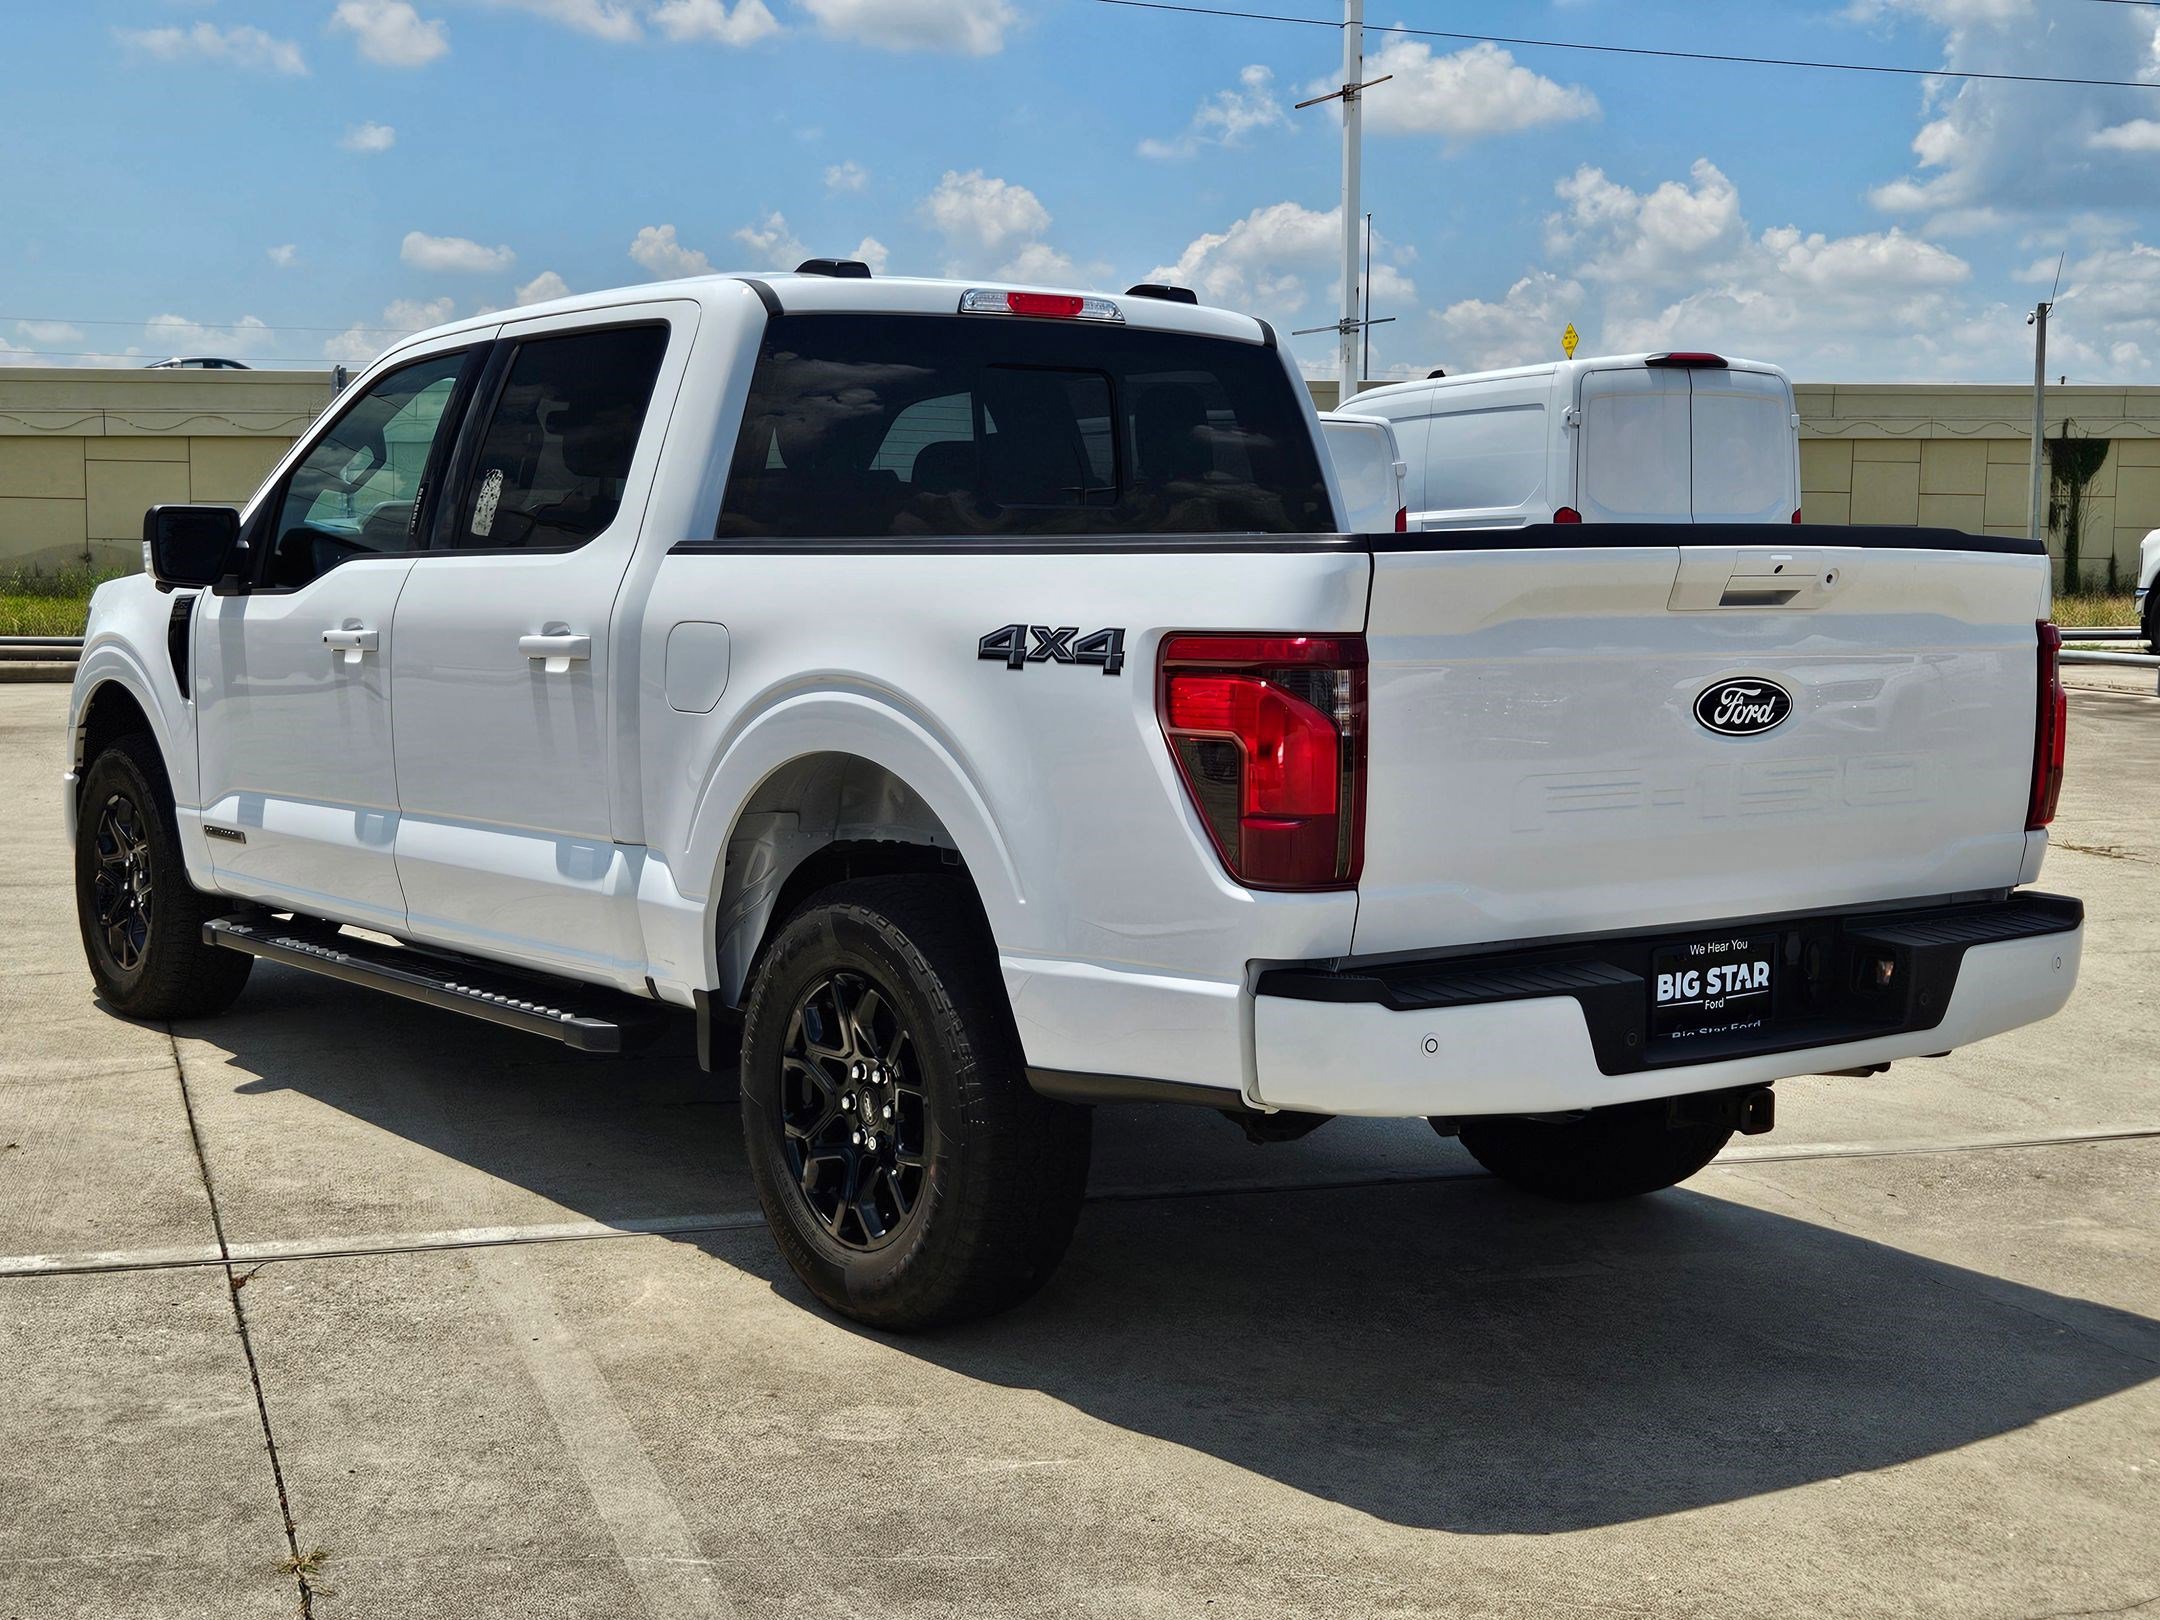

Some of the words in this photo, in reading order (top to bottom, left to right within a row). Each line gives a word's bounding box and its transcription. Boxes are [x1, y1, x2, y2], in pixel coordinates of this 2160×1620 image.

[1713, 687, 1776, 725] Ford
[1690, 944, 1706, 955] We
[1707, 942, 1729, 953] Hear
[1731, 939, 1748, 951] You
[1657, 970, 1701, 1002] BIG
[1706, 961, 1770, 995] STAR
[1704, 997, 1725, 1010] Ford
